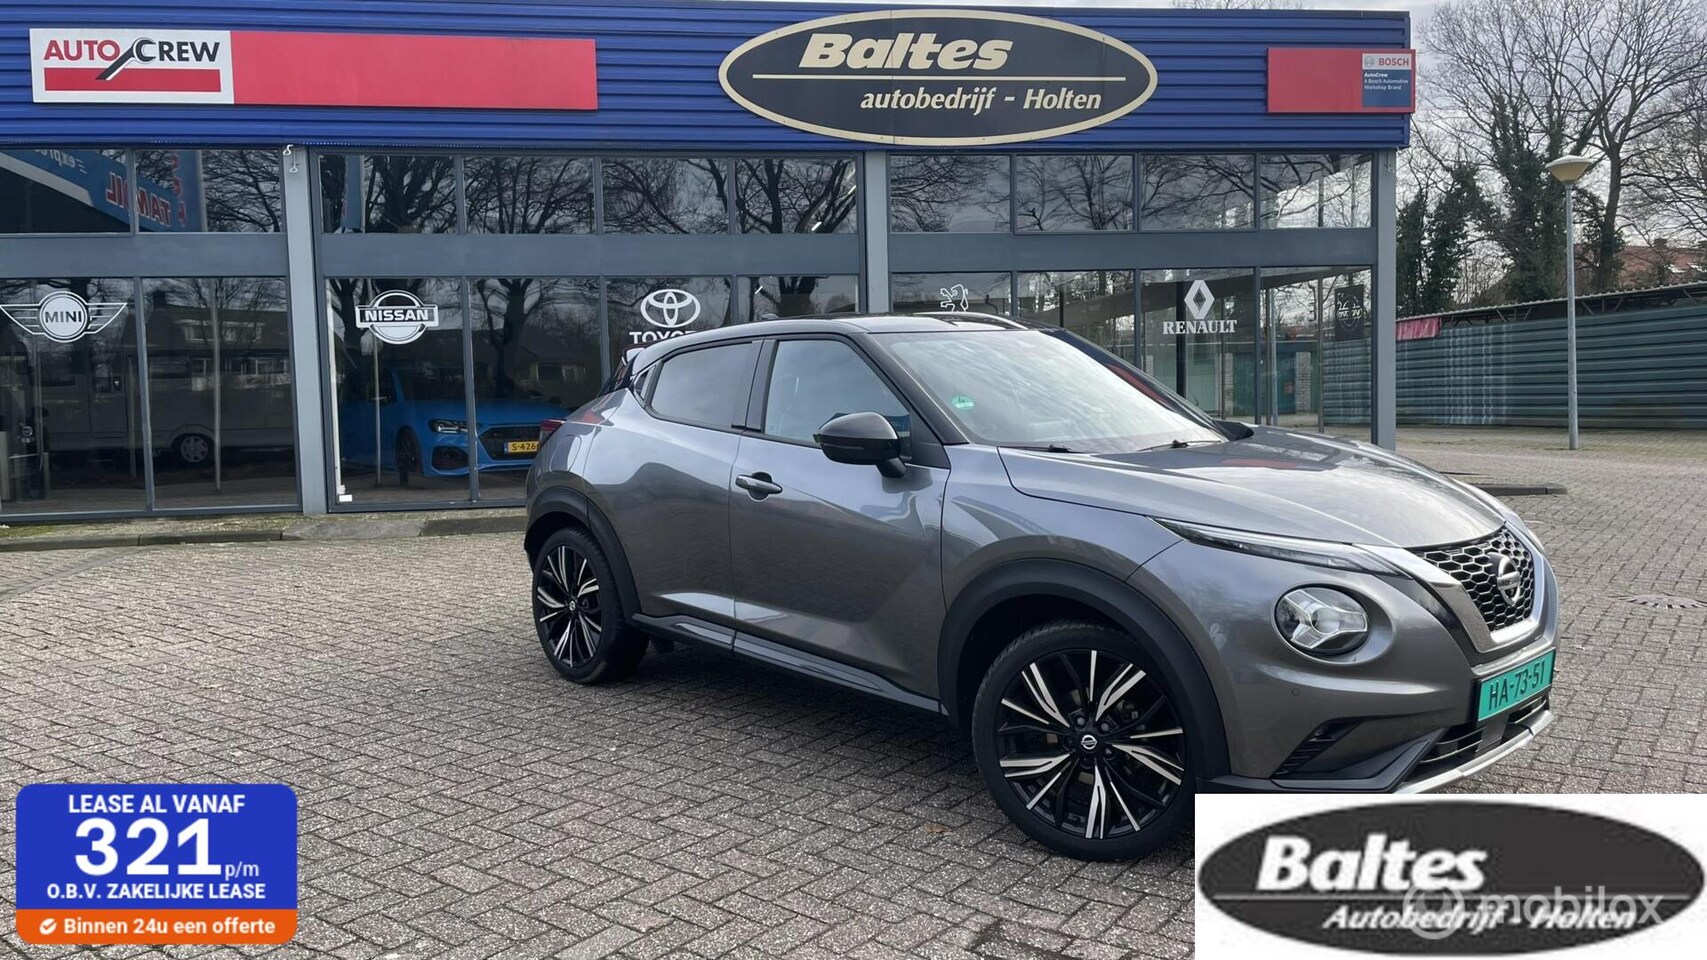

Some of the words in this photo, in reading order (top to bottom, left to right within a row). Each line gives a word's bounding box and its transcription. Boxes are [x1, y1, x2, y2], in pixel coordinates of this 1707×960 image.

[799, 33, 1013, 70] Baltes
[1378, 58, 1409, 66] BOSCH
[860, 88, 997, 115] autobedrijf
[1023, 88, 1101, 109] Holten
[45, 311, 82, 323] MINI
[365, 309, 429, 322] NISSAN
[1163, 320, 1238, 335] RENAULT
[629, 330, 697, 344] TOY
[1488, 659, 1546, 711] HA-73-51
